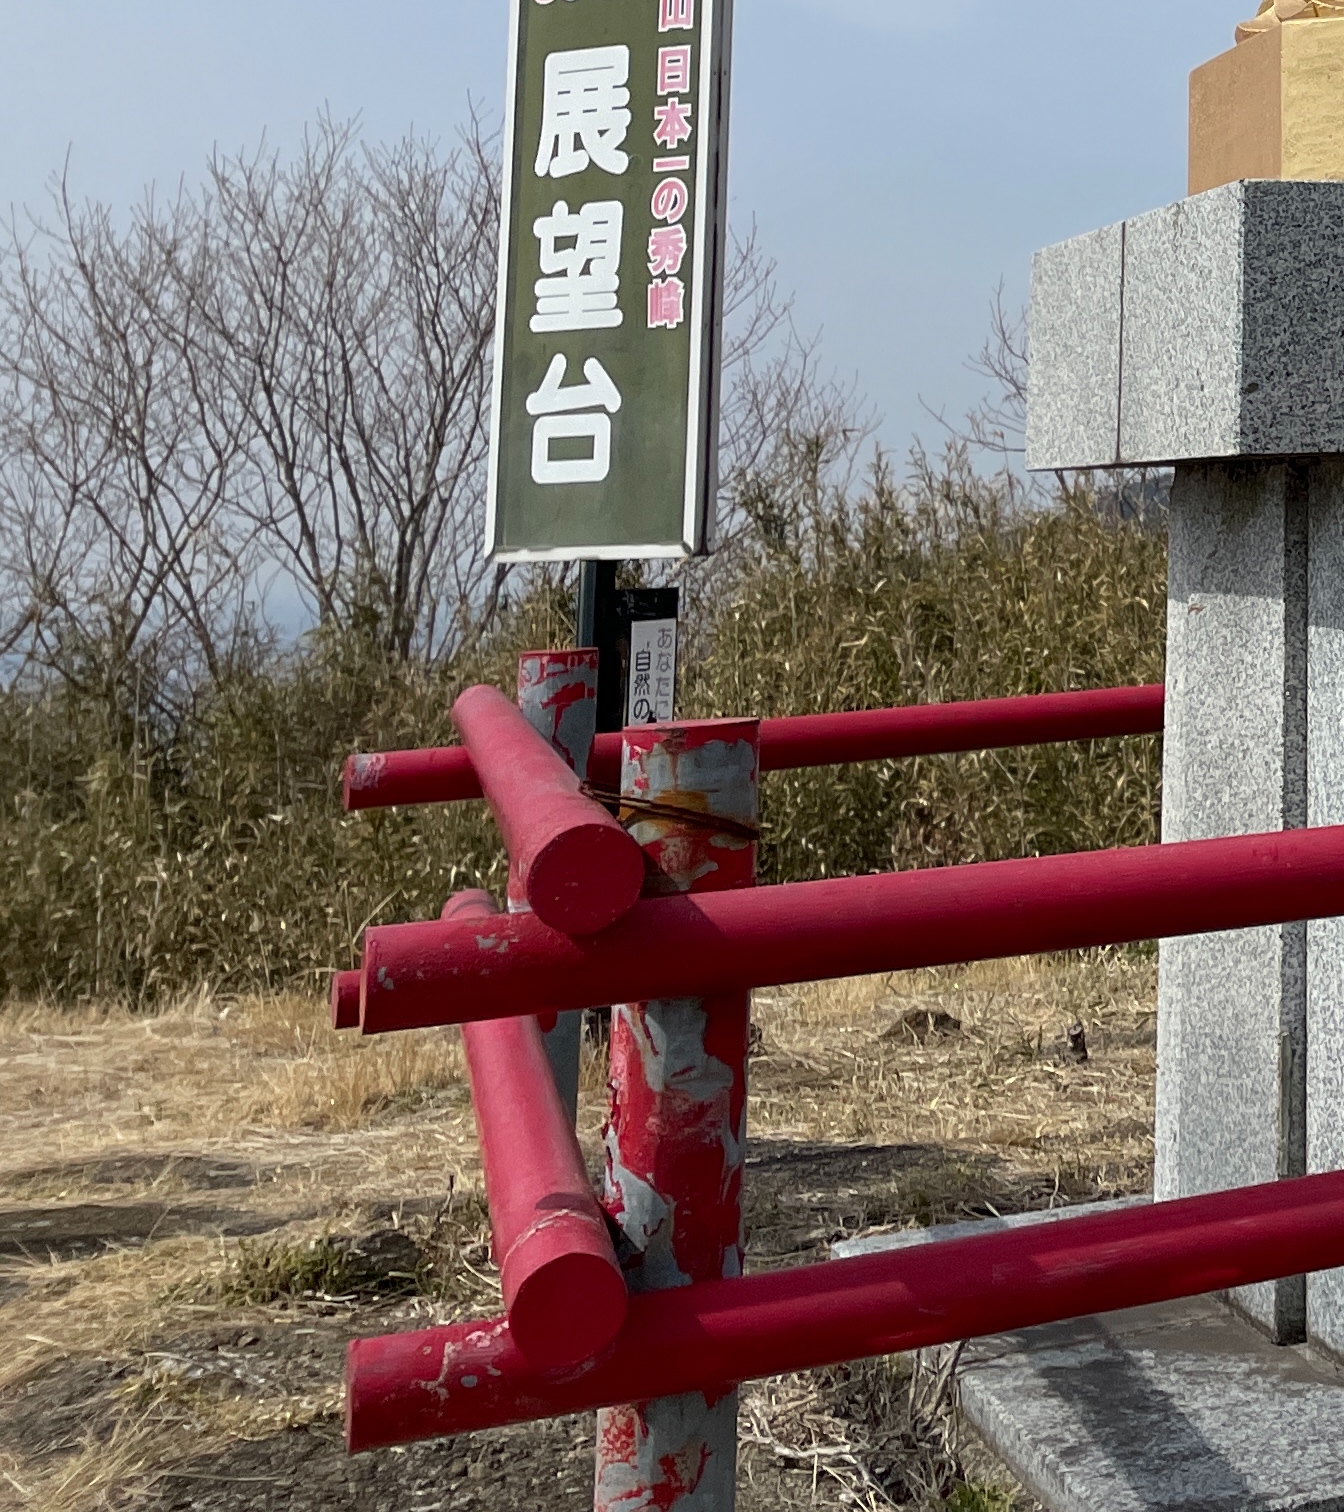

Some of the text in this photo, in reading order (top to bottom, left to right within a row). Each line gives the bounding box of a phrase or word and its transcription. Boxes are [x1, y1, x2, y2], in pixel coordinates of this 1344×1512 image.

[526, 45, 631, 484] 展望台
[647, 45, 692, 329] 日本一の秀峰
[655, 628, 672, 720] あなたに
